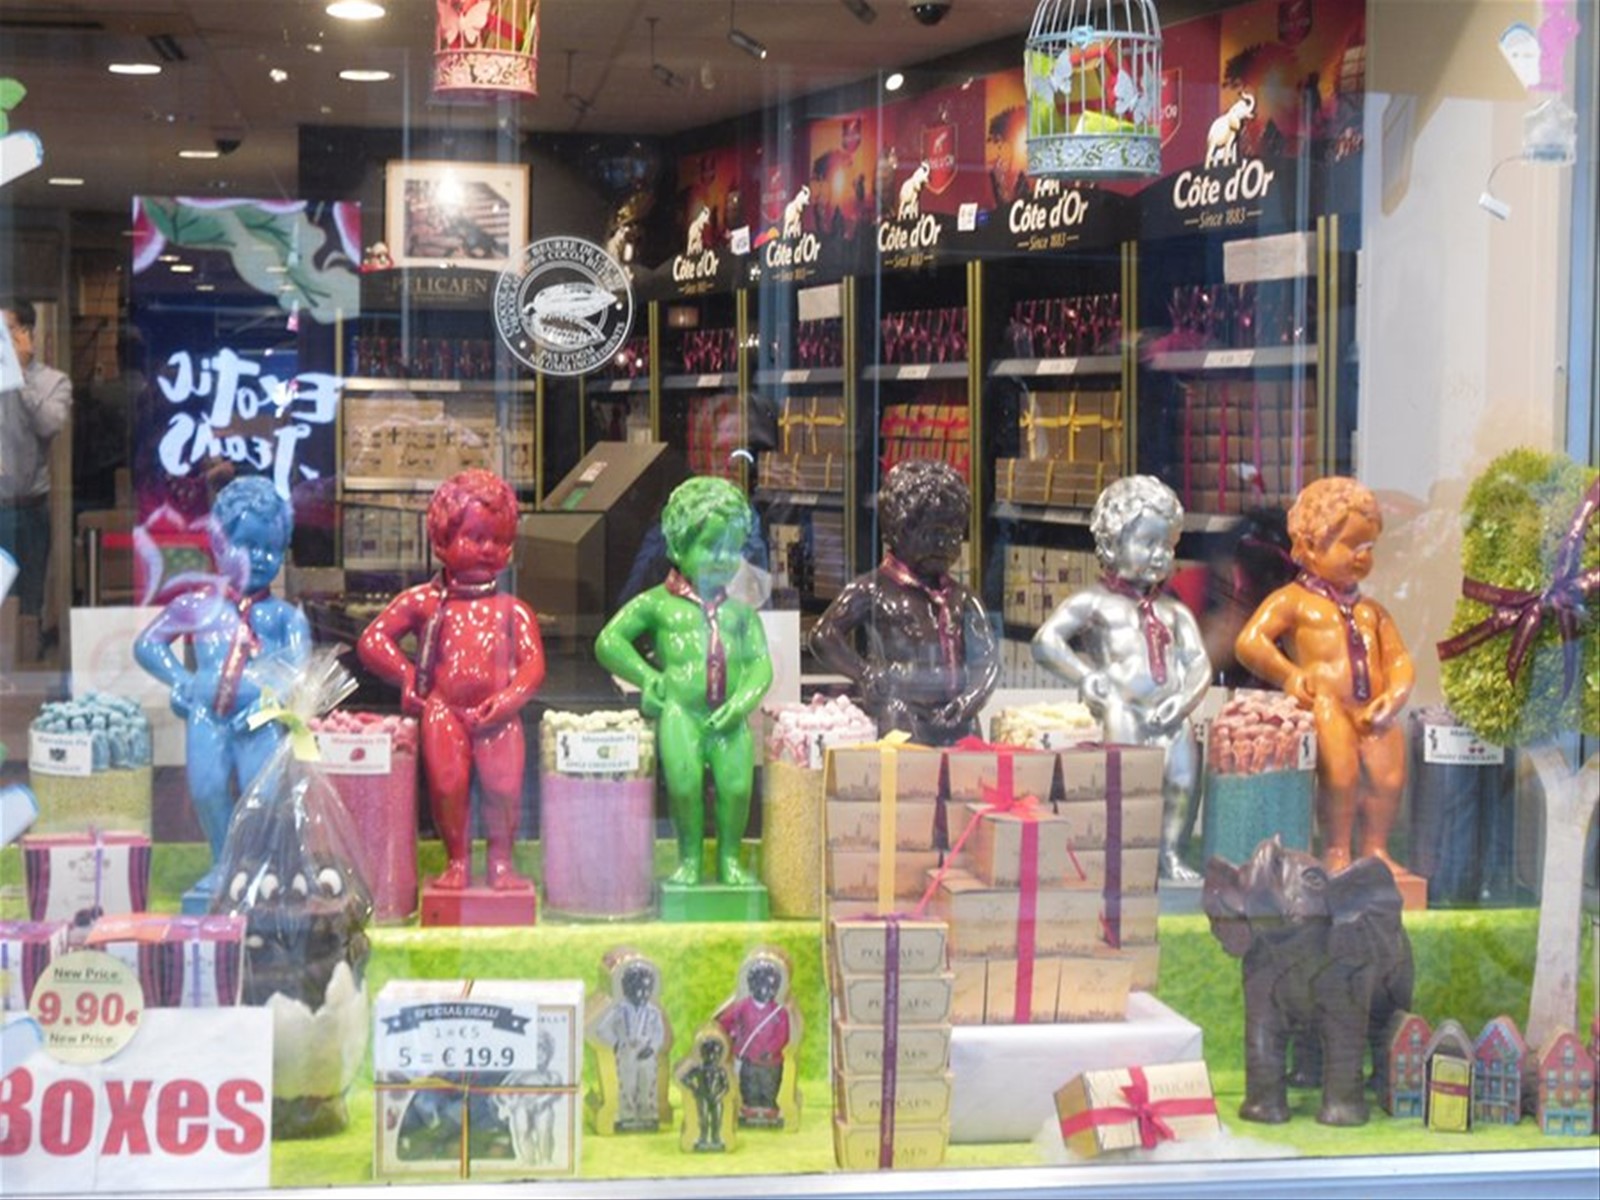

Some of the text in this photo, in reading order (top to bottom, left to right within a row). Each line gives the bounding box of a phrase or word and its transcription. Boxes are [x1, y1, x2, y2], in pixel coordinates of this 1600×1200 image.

[1173, 158, 1274, 209] Côte d'Or
[1009, 199, 1046, 234] Côte
[1049, 190, 1088, 227] d'Or
[1199, 207, 1246, 229] Since 1883
[877, 220, 906, 252] Côte
[909, 213, 941, 248] d'Or
[672, 248, 719, 281] Côte d'Or
[766, 240, 792, 268] Côte
[793, 232, 821, 265] d'Or
[861, 947, 925, 958] PELAEN
[54, 967, 118, 979] New Price
[37, 990, 139, 1026] 9.90€
[49, 1032, 114, 1043] New Price
[399, 1046, 413, 1068] 5
[442, 1046, 455, 1068] €
[464, 1046, 515, 1068] 19.9
[0, 1066, 265, 1157] Boxes
